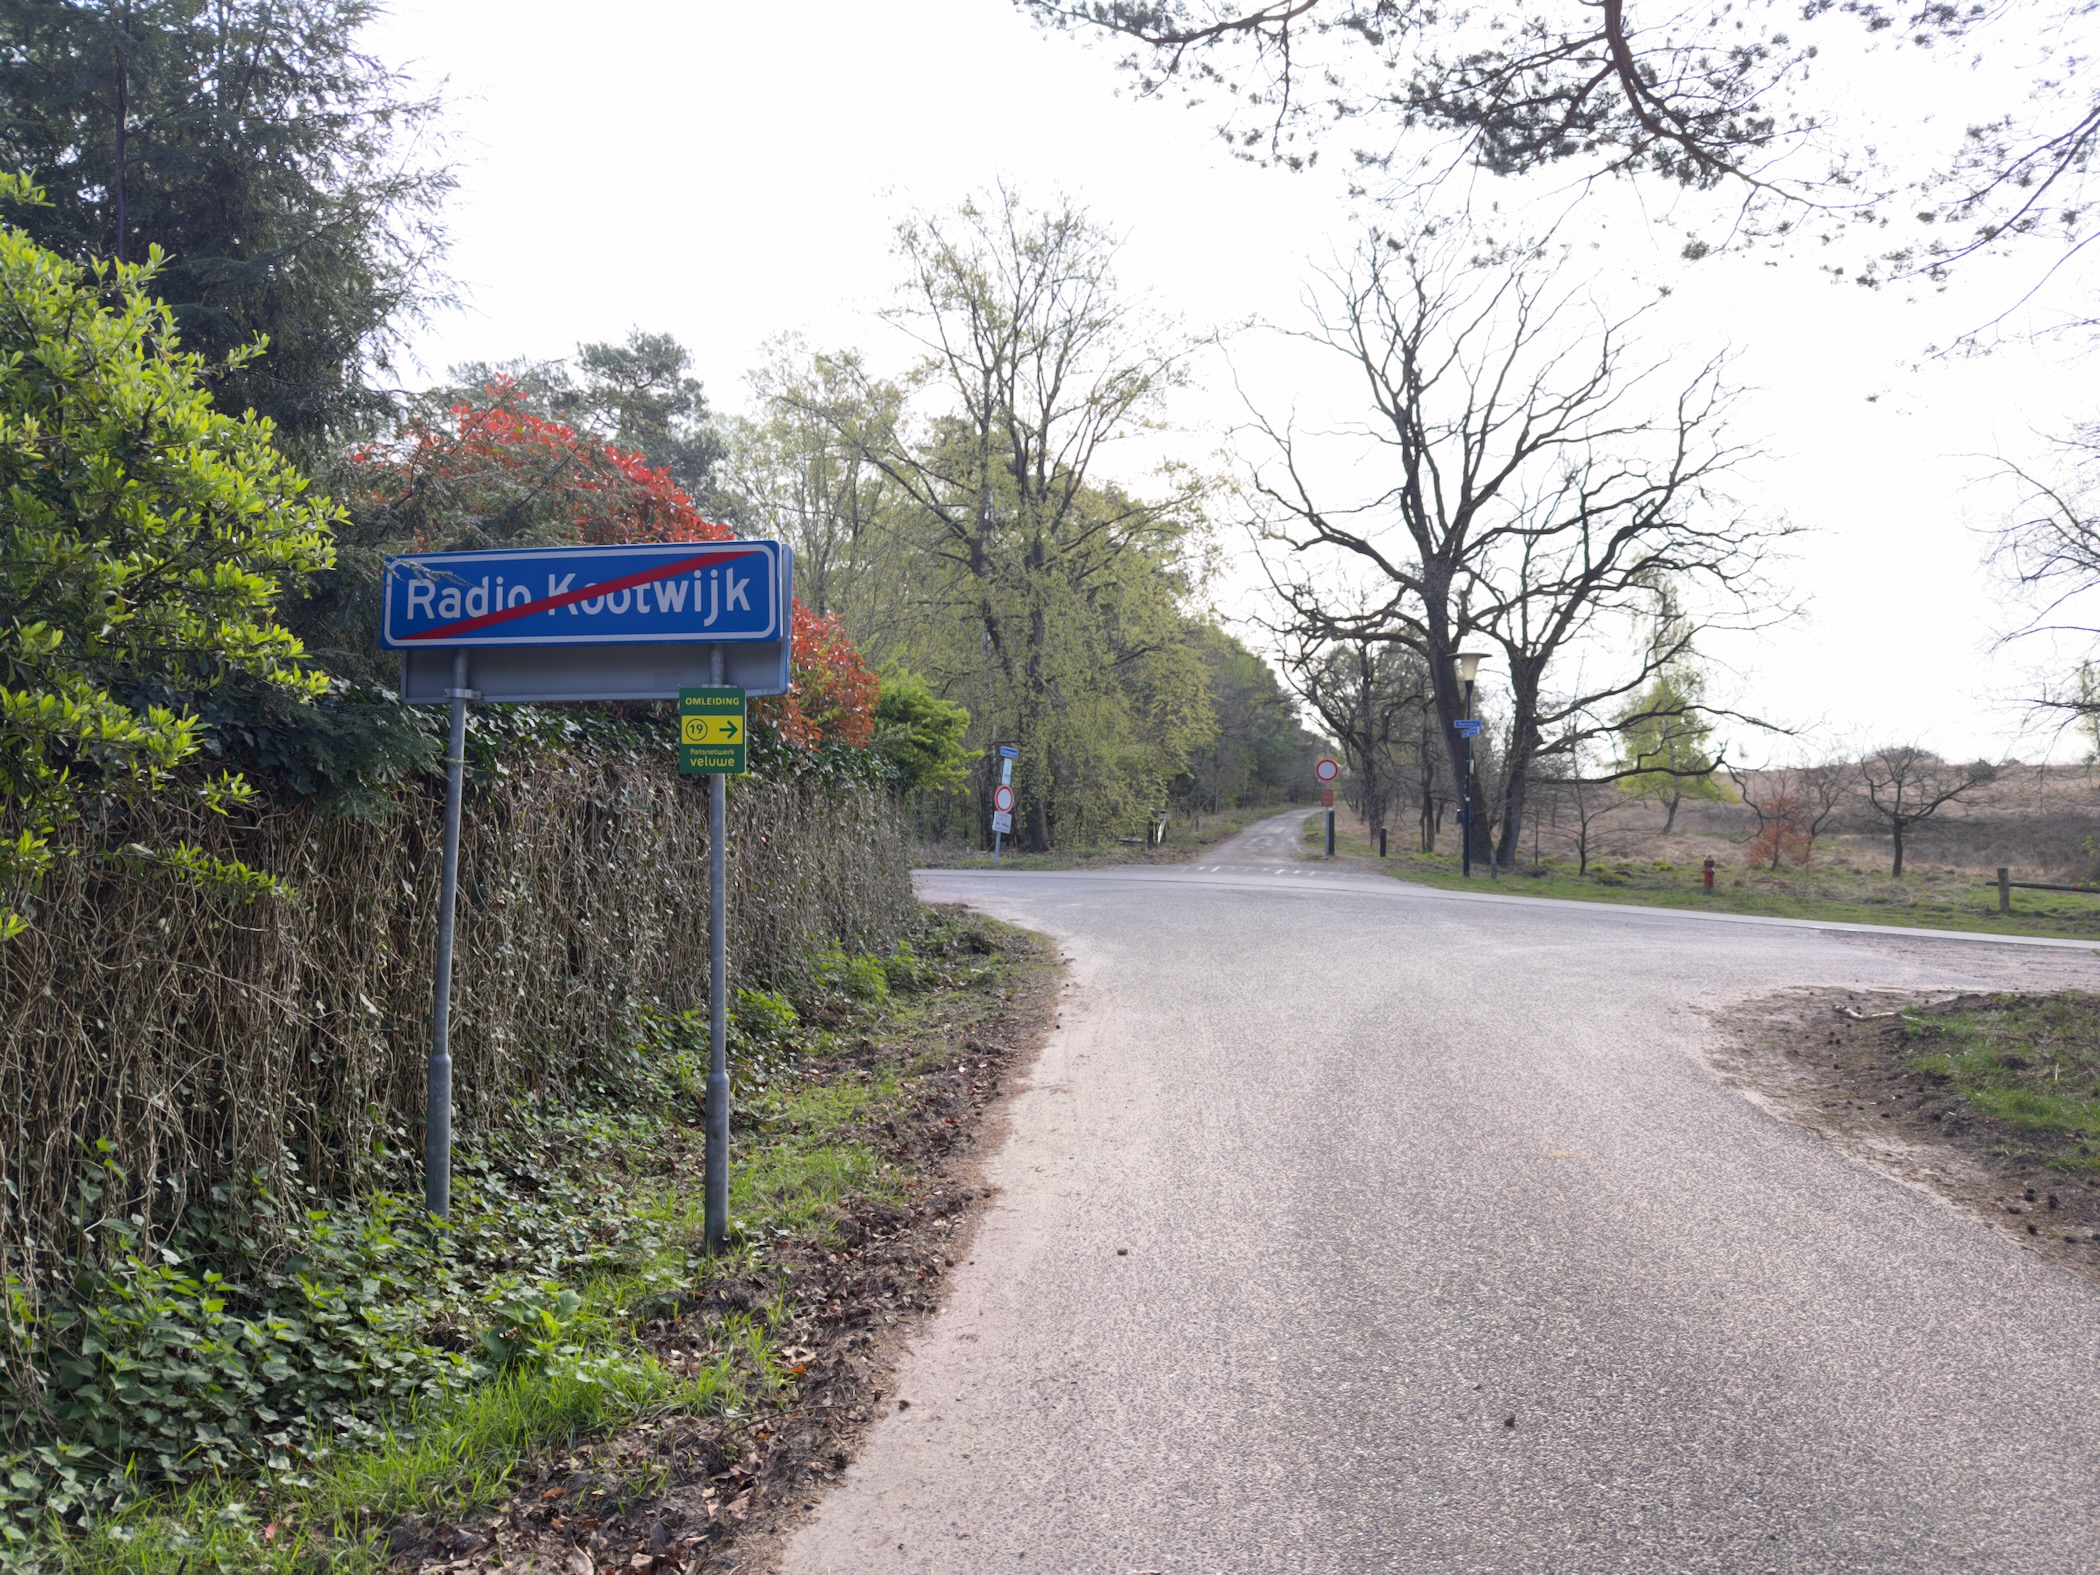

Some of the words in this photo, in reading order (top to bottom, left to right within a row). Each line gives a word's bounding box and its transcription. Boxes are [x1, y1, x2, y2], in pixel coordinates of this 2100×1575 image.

[407, 575, 532, 620] Radio
[548, 567, 751, 627] Kootwijk
[685, 697, 740, 705] OMLEIDING
[689, 724, 703, 734] 19
[690, 756, 735, 766] veluwe
